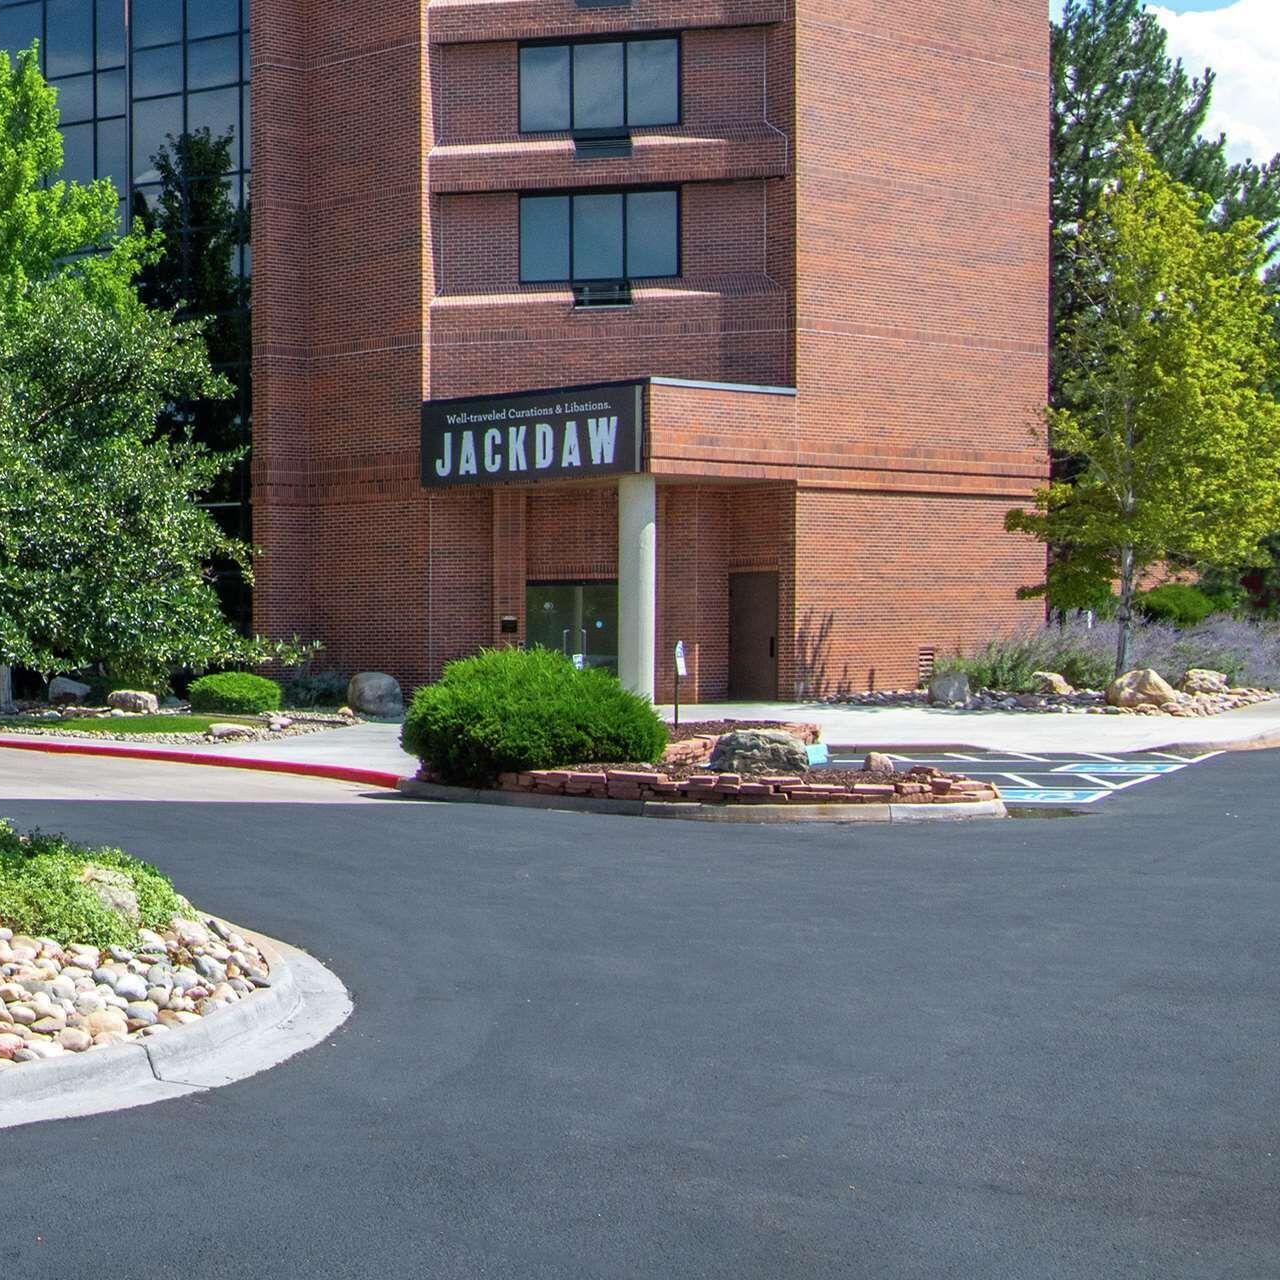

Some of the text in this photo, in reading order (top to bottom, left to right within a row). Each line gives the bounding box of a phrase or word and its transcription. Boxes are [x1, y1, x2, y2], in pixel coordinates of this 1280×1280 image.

[446, 401, 611, 424] Well-traveled Curations & Libations.
[435, 416, 618, 477] JACKDAW
